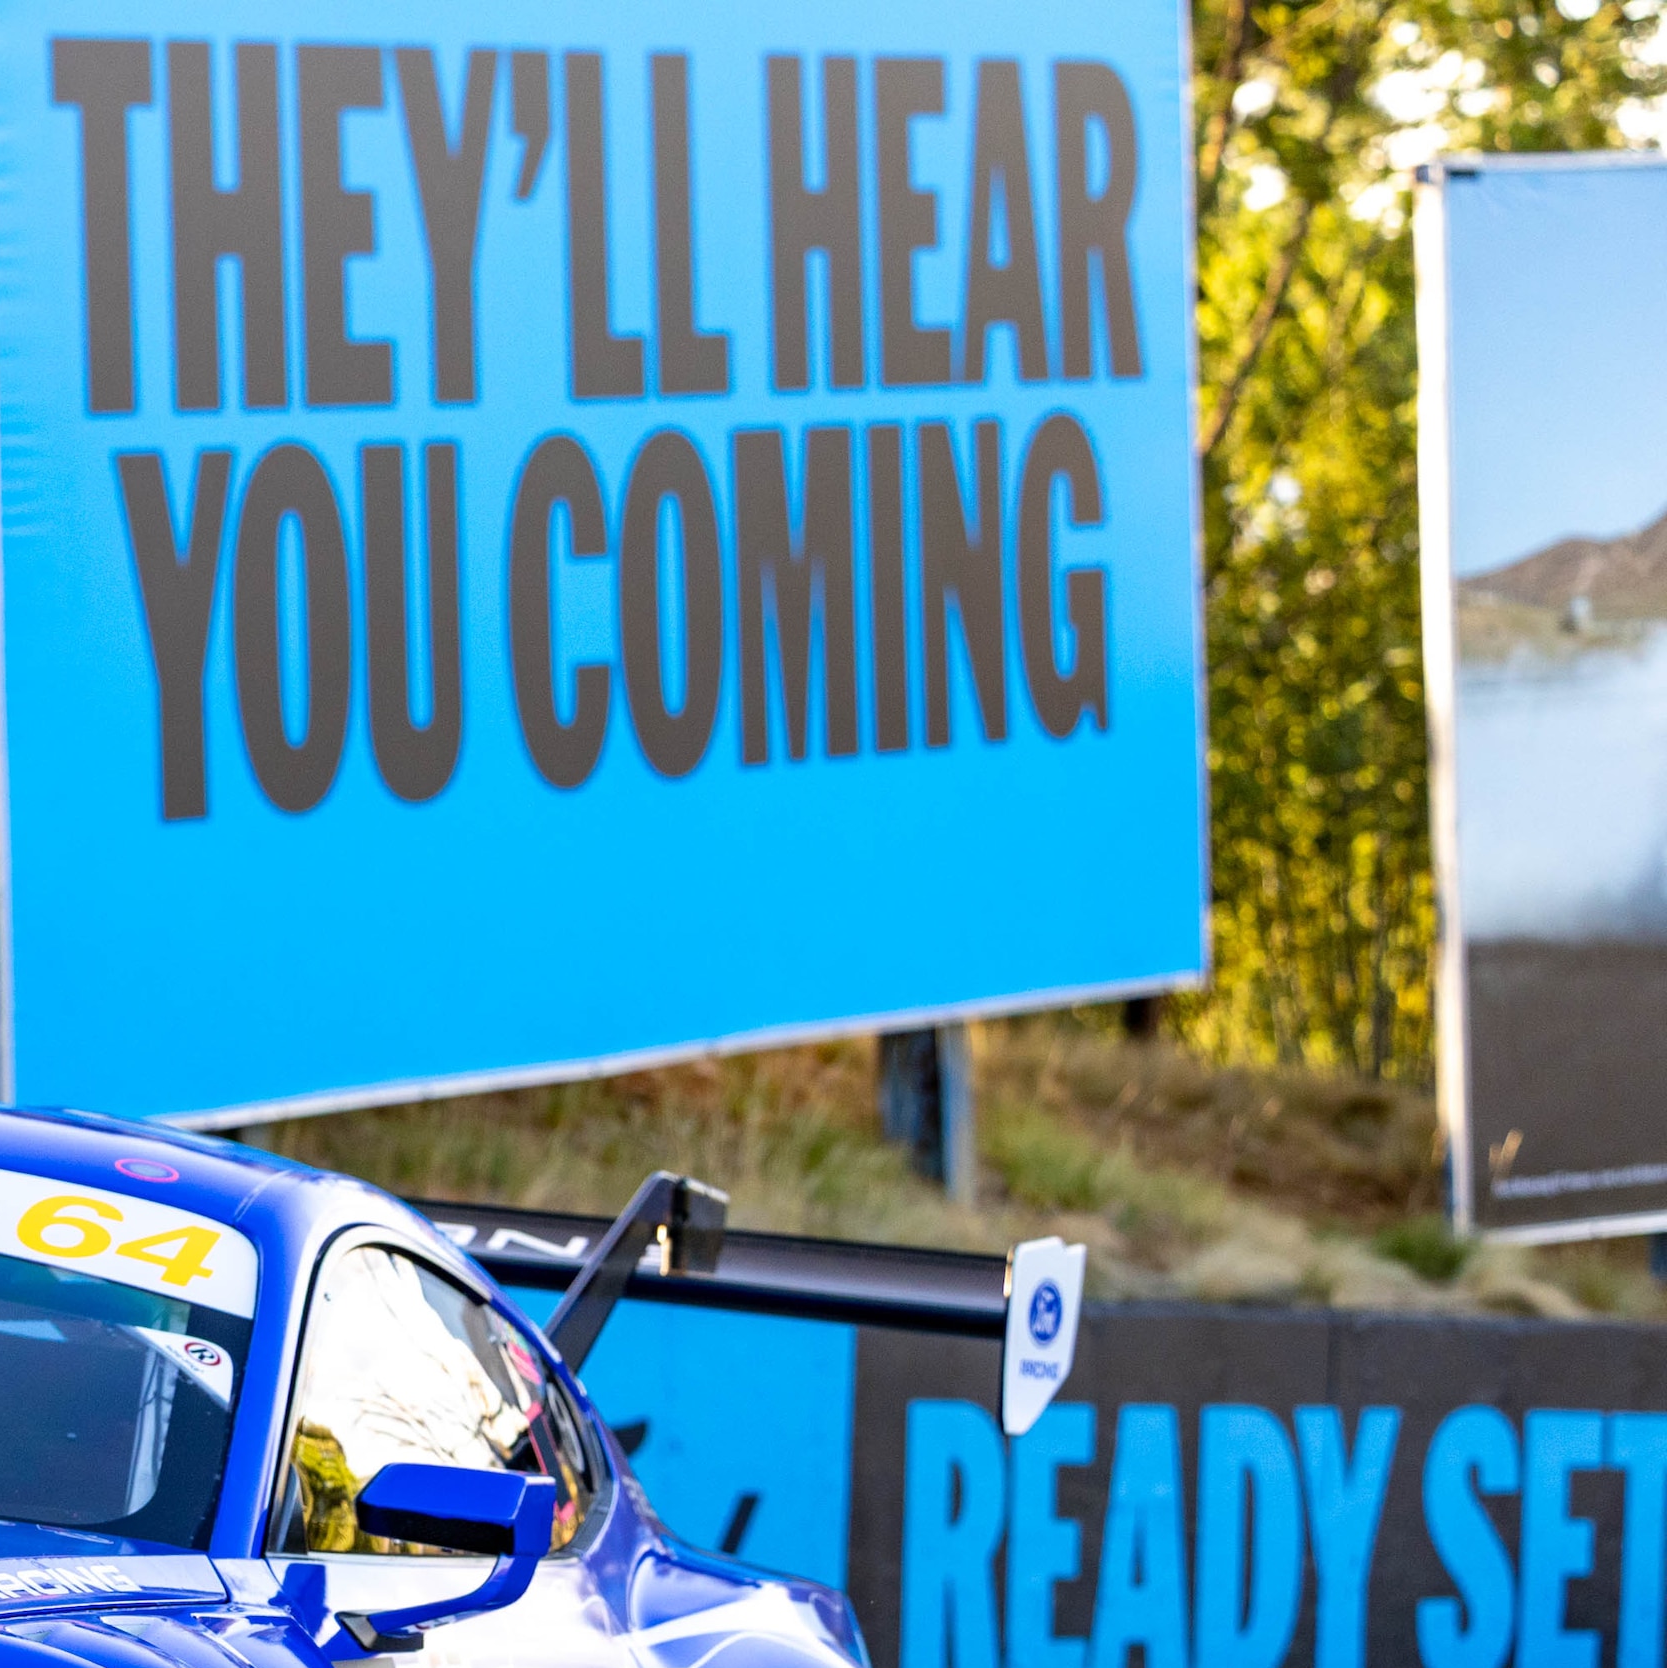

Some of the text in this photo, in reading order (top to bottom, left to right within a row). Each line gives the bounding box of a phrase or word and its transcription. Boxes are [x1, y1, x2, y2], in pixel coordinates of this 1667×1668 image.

[765, 53, 1144, 392] HEAR
[115, 412, 1108, 822] YOU COMING
[17, 1196, 222, 1286] 64
